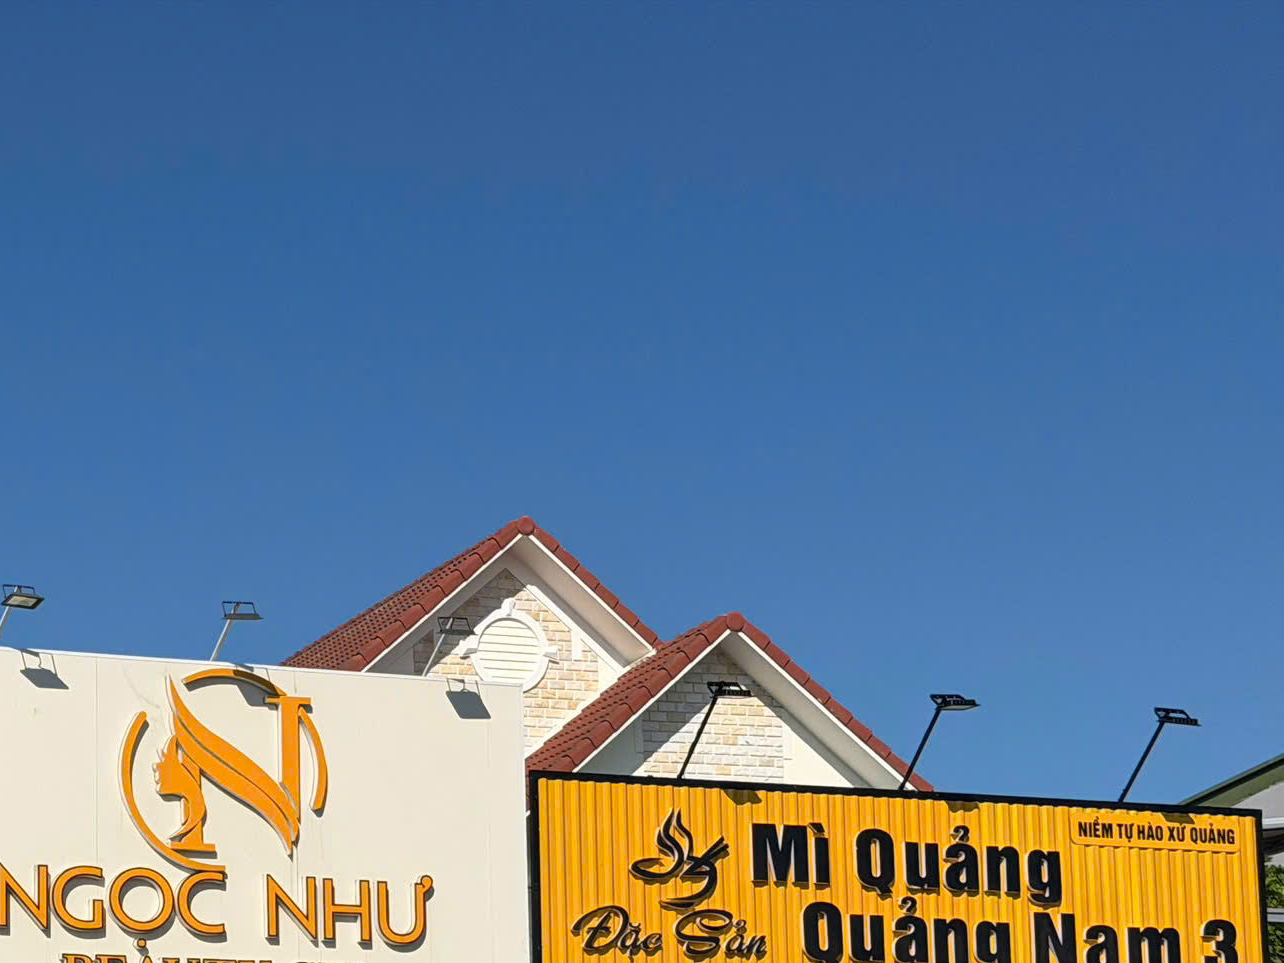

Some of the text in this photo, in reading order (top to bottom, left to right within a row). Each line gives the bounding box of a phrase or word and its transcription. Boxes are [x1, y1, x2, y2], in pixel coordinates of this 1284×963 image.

[1078, 816, 1236, 845] NIỀM TỰ HÀO XỨ QUẢNG
[750, 822, 1063, 906] Mì Quảng
[265, 874, 435, 946] NHƯ
[571, 905, 768, 963] Đặc Sản
